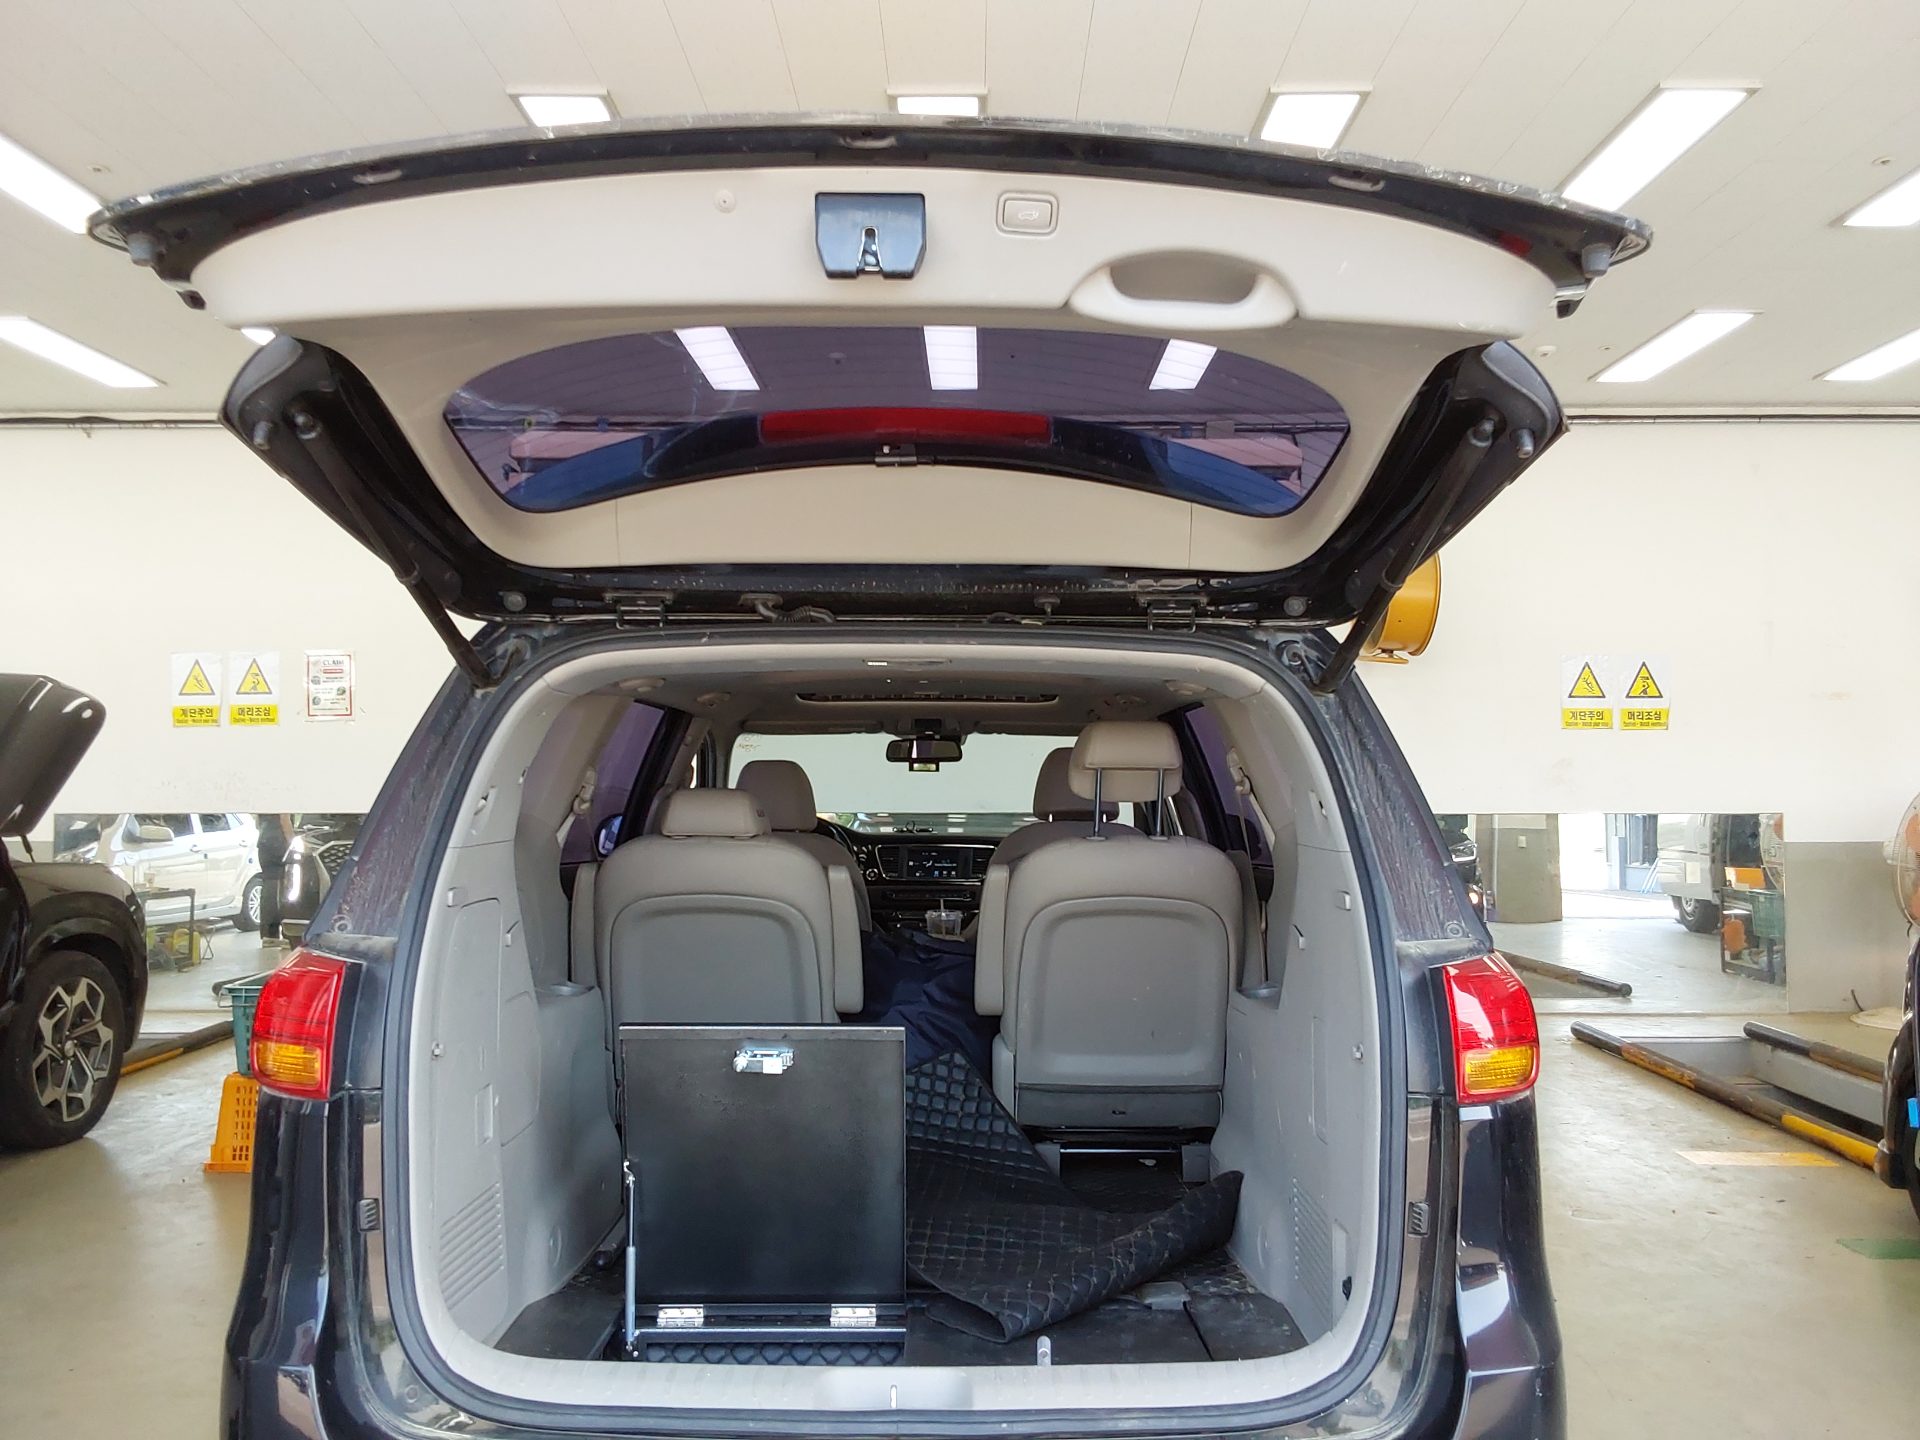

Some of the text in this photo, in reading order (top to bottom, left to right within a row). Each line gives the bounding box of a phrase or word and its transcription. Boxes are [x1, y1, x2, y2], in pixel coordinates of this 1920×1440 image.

[180, 707, 214, 718] 계단주의
[237, 706, 271, 717] 머리조심
[1569, 710, 1605, 721] 계단주의
[1627, 710, 1662, 721] 머리조심
